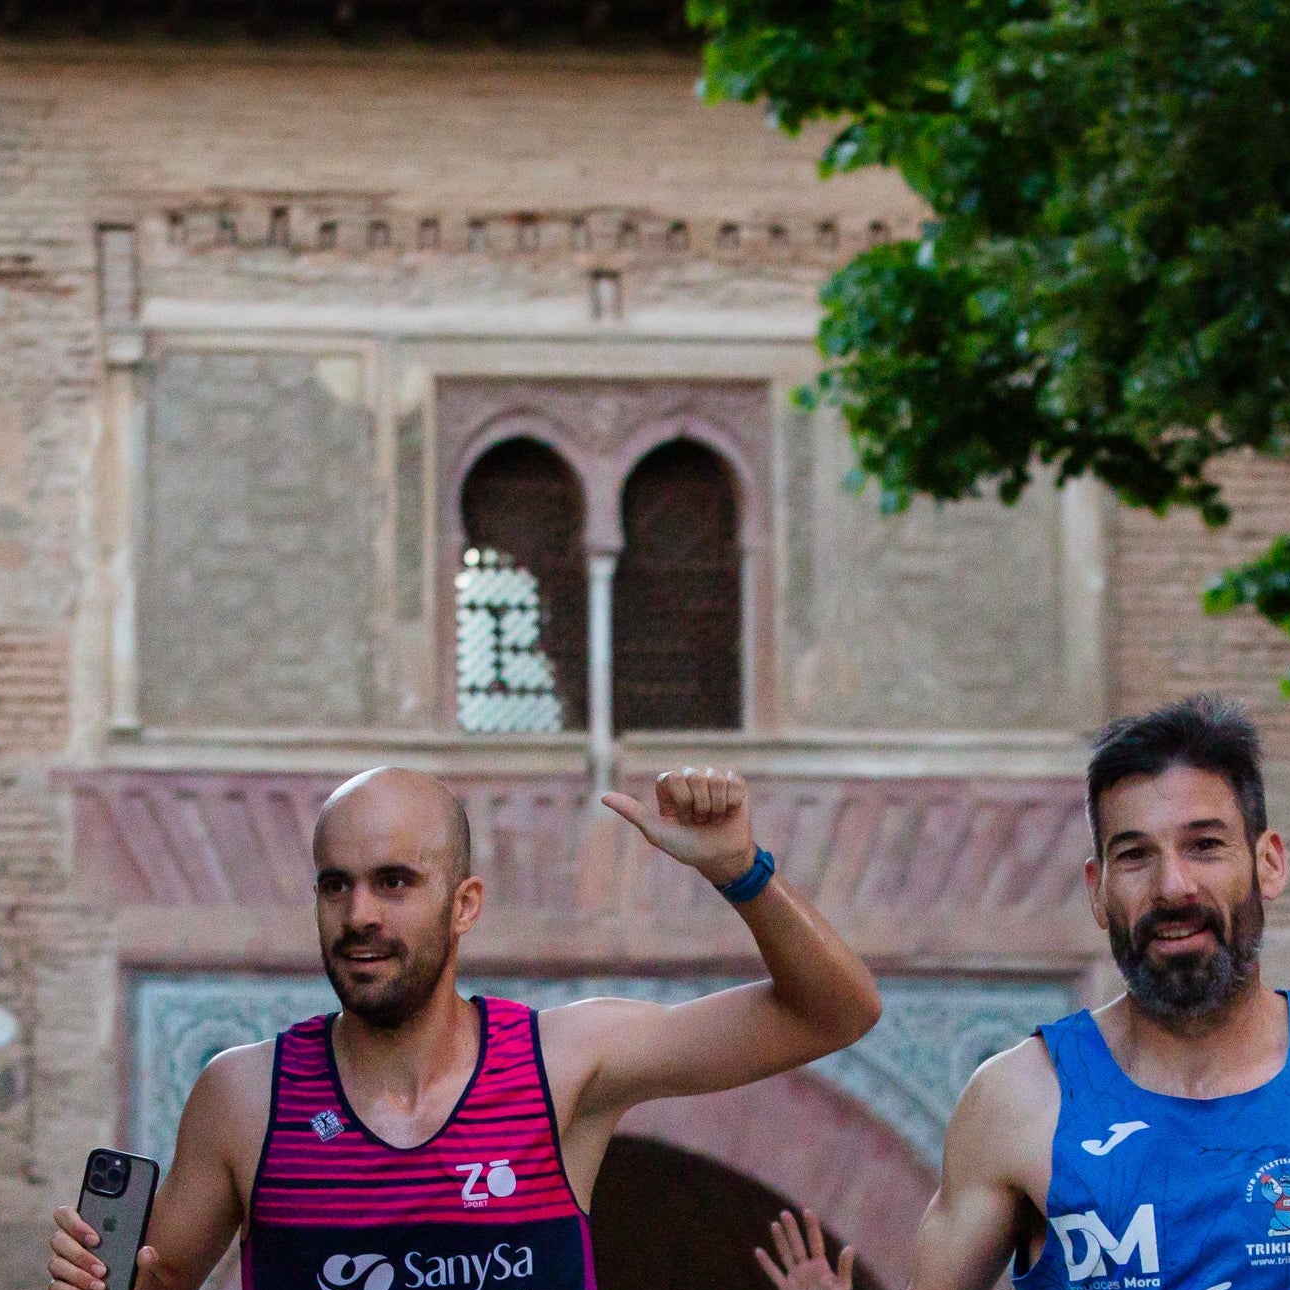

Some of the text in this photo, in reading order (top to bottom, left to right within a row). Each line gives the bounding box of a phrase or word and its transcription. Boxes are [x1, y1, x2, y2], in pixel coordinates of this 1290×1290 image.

[1246, 1178, 1256, 1203] CLUB
[463, 1200, 488, 1209] SPORT
[1124, 1276, 1160, 1289] Mora
